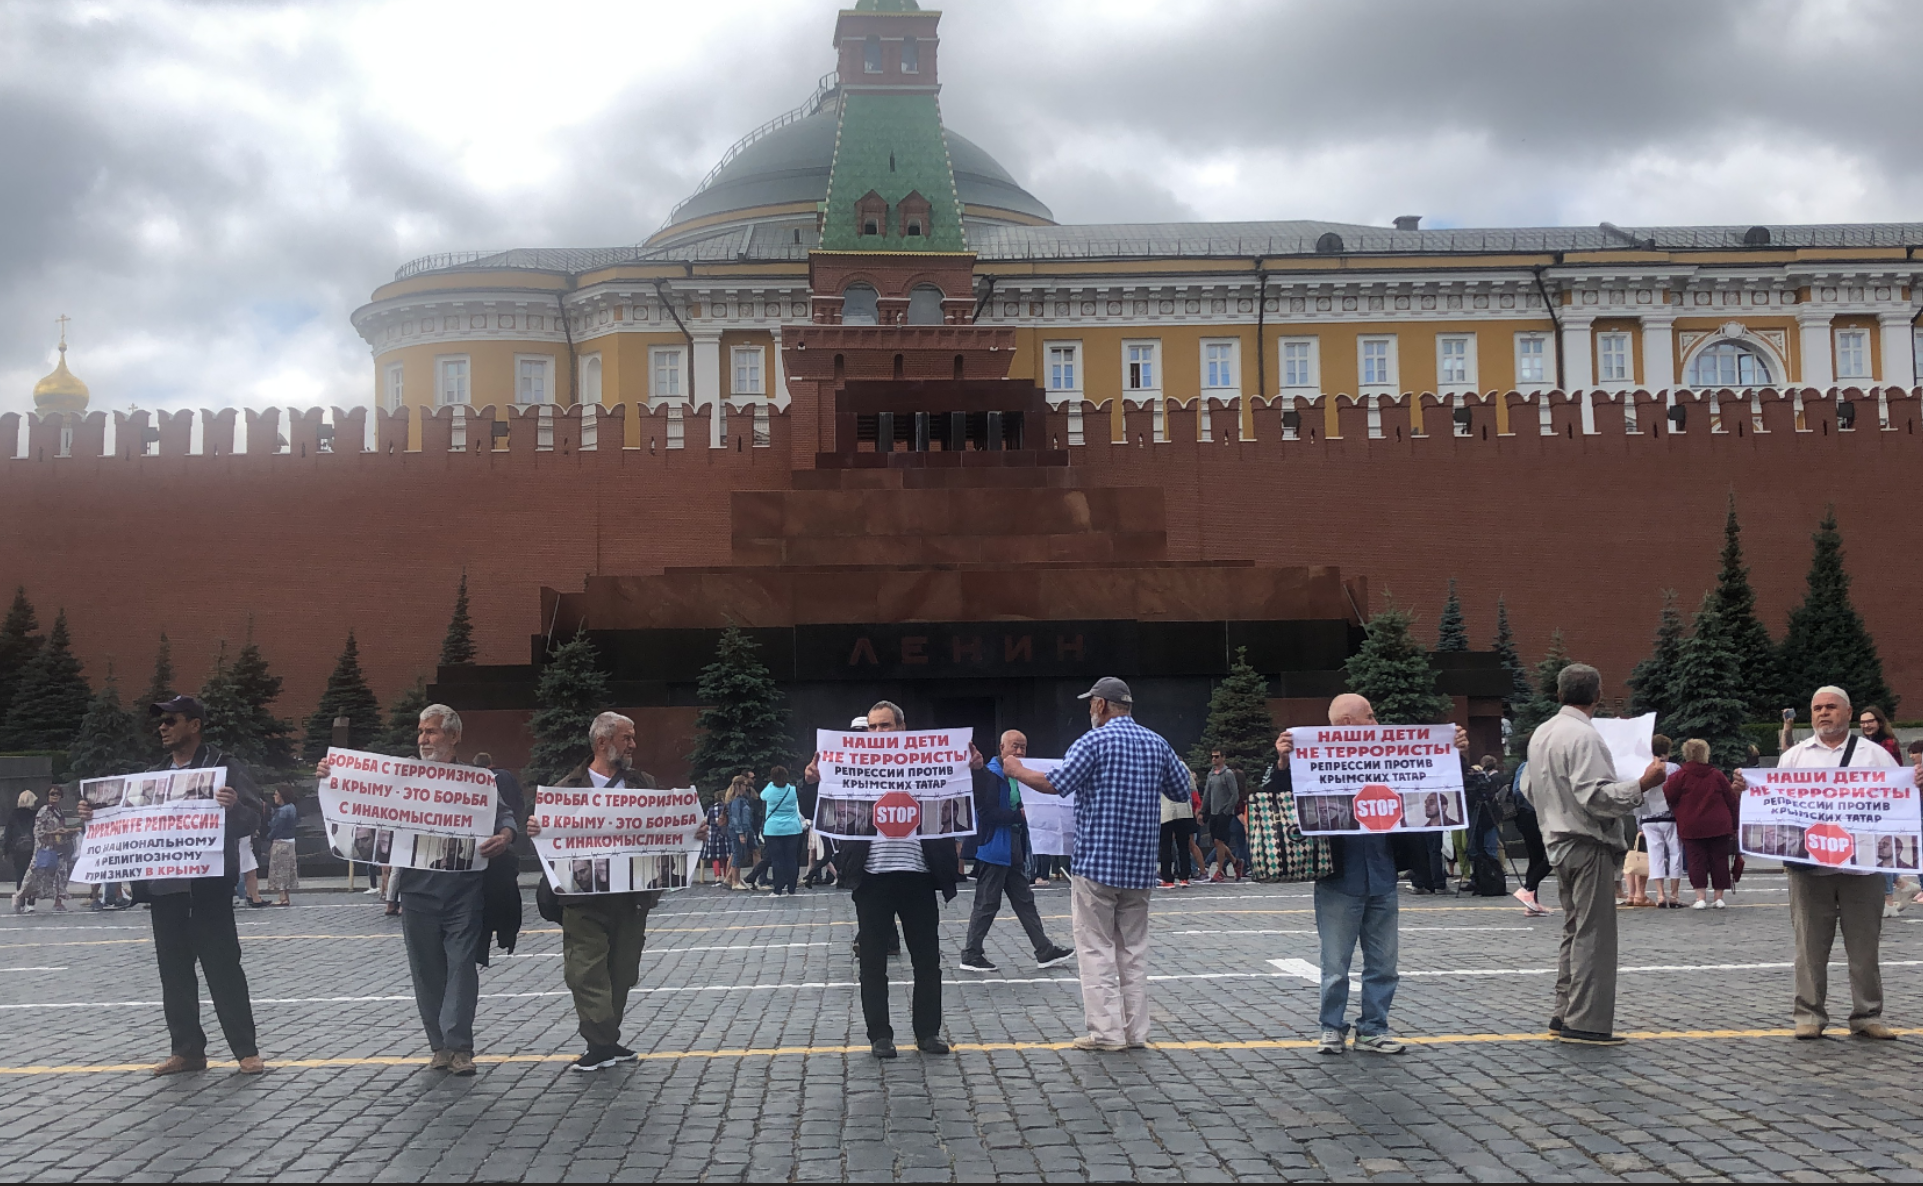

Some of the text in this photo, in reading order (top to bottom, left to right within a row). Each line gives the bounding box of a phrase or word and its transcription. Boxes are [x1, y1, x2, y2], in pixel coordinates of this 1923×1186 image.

[850, 634, 1084, 665] ЛЕНИН
[842, 735, 949, 750] НАШИ ДЕТИ
[1318, 728, 1430, 743] НАШИ ДЕТИ
[822, 750, 967, 765] НЕ ТЕРРОРИСТЫ
[1296, 743, 1451, 759] НЕ ТЕРРОРИСТЫ
[328, 753, 496, 788] БОРЬБА С ТЕРРОРИЗМОМ
[834, 766, 954, 778] РЕПРЕССИИ ПРОТИВ
[1310, 759, 1433, 772] РЕПРЕССИИ ПРОТИВ
[842, 779, 947, 790] КРЫМСКИХ ТАТАР
[1319, 772, 1427, 784] КРЫМСКИХ ТАТАР
[1767, 771, 1886, 784] НАШИ ДЕТИ
[330, 777, 338, 789] В
[342, 779, 393, 798] КРЫМУ
[403, 787, 430, 801] ЭТО
[434, 790, 488, 807] БОРЬБА
[536, 791, 589, 806] БОРЬБА
[592, 793, 601, 807] С
[1750, 785, 1910, 799] НЕ ТЕРРОРИСТЫ
[1357, 799, 1398, 817] STOP
[1763, 797, 1890, 811] РЕПРЕССИИ ПРОТИВ
[339, 801, 473, 828] С ИНАКОМЫСЛИЕМ
[541, 815, 550, 828] В
[553, 815, 606, 829] КРЫМУ
[615, 817, 642, 830] ЭТО
[646, 813, 697, 829] БОРЬБА
[877, 806, 917, 824] STOP
[1845, 814, 1882, 823] ТАТАР
[144, 813, 220, 833] РЕПРЕССИИ
[87, 836, 217, 855] ПО НАЦИОНАЛЬНОМУ
[552, 833, 683, 850] С ИНАКОМЫСЛИЕМ
[1807, 834, 1849, 853] STOP
[101, 852, 202, 867] РЕЛИГИОЗНОМУ
[85, 865, 210, 881] ПРИЗНАКУ В КРЫМУ
